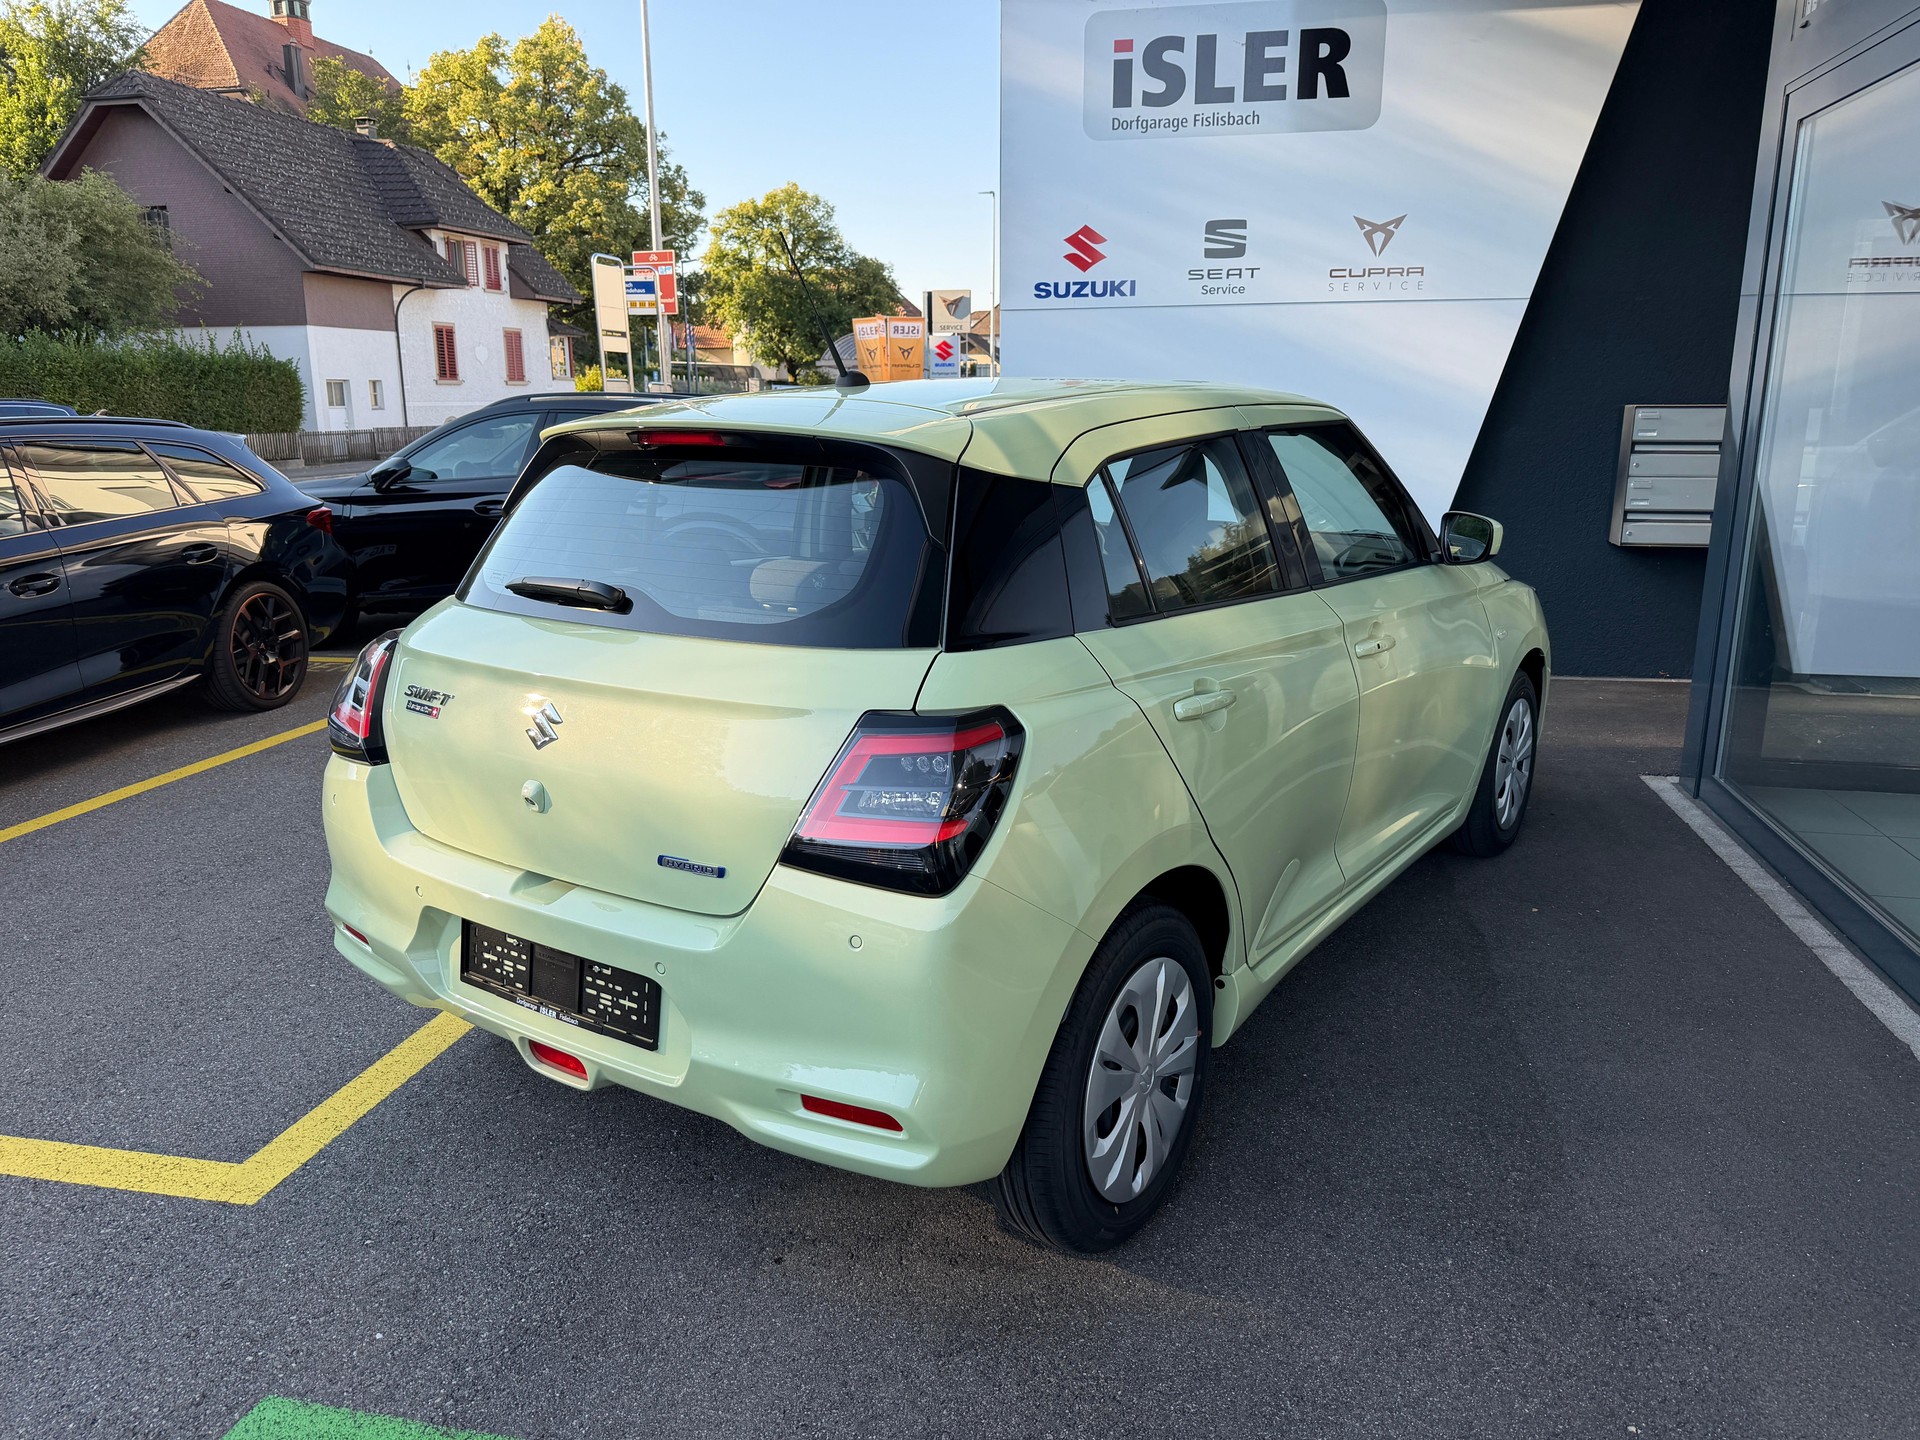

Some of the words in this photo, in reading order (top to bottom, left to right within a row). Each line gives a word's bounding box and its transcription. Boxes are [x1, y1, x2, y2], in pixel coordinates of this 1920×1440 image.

[1111, 115, 1188, 133] Dorfgarage
[1193, 110, 1260, 127] Fislisbach
[1188, 267, 1260, 280] SEAT
[1329, 266, 1424, 278] CUPRA
[1034, 279, 1136, 299] SUZUKI
[1201, 283, 1246, 295] Service
[404, 684, 452, 706] SWIFT
[666, 859, 714, 874] HYBRID
